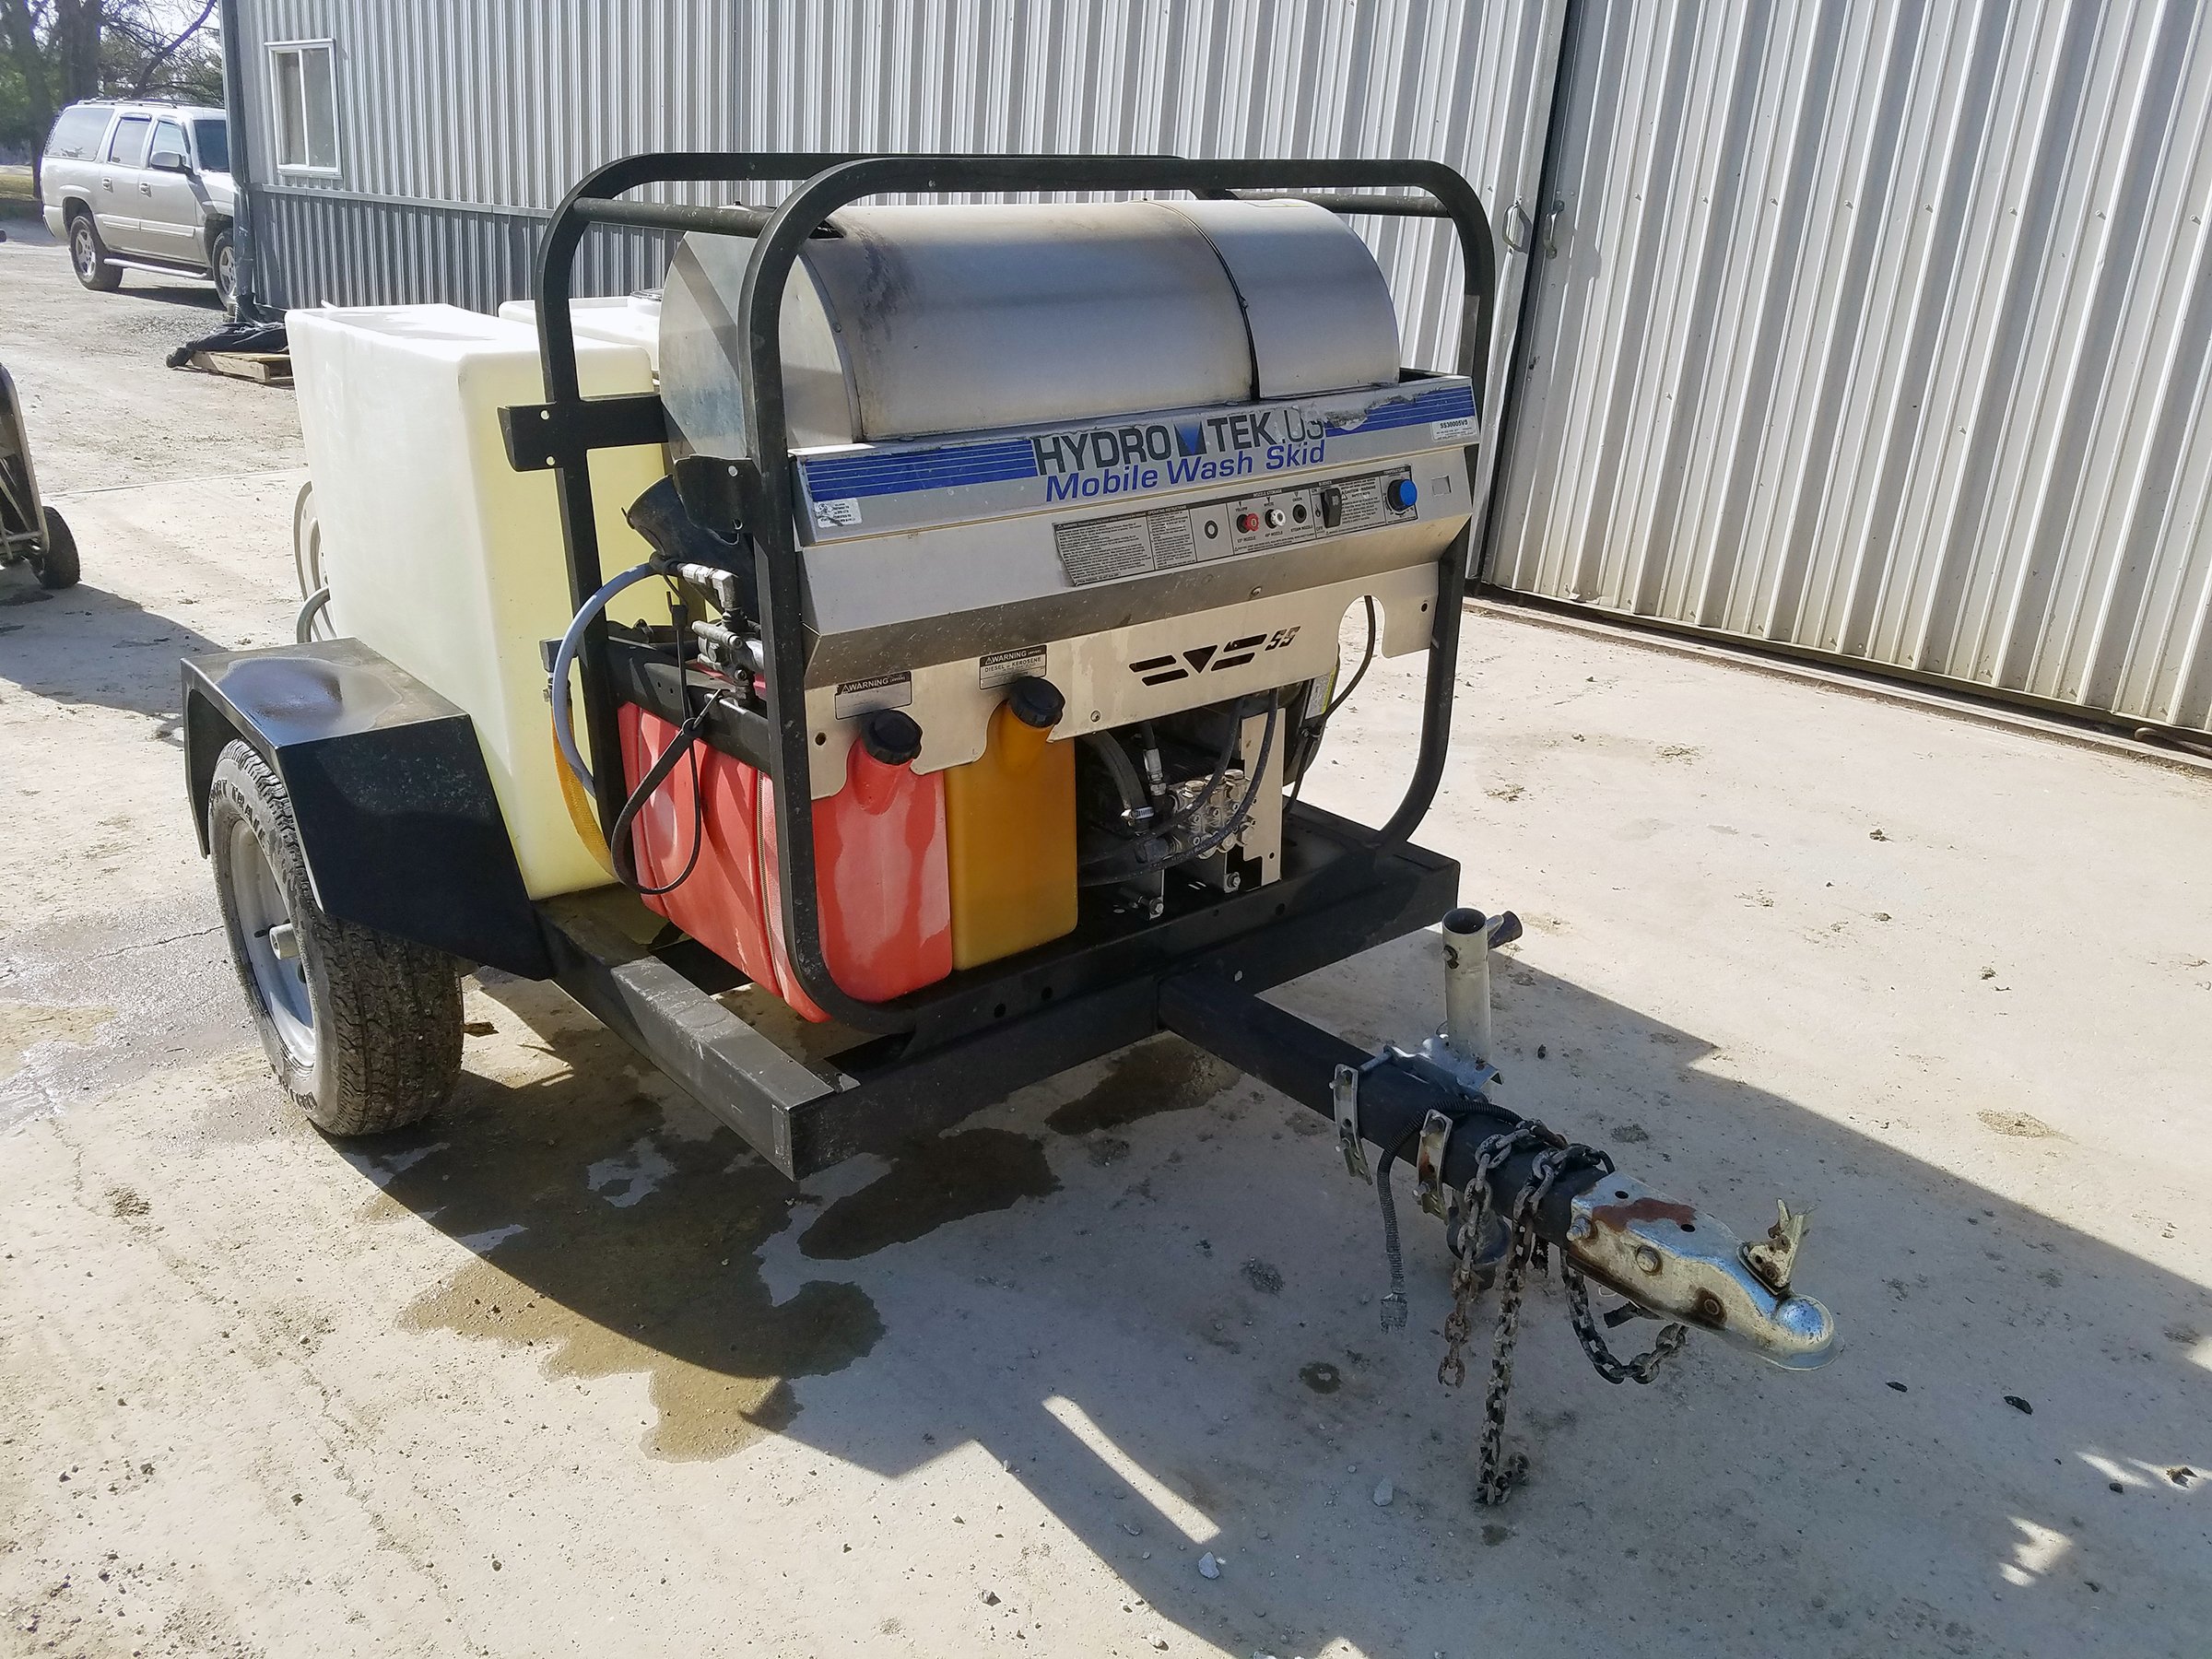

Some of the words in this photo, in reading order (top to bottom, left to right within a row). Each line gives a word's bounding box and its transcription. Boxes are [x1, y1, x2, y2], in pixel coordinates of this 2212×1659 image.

[1034, 425, 1172, 476] HYDRO
[1045, 463, 1158, 502] Mobile
[1166, 449, 1253, 485] Wash
[1265, 440, 1325, 470] Skid
[993, 650, 1028, 663] WARNING
[984, 665, 1005, 673] DIESEL
[1012, 657, 1041, 667] KEROSENE
[848, 677, 888, 691] WARNING
